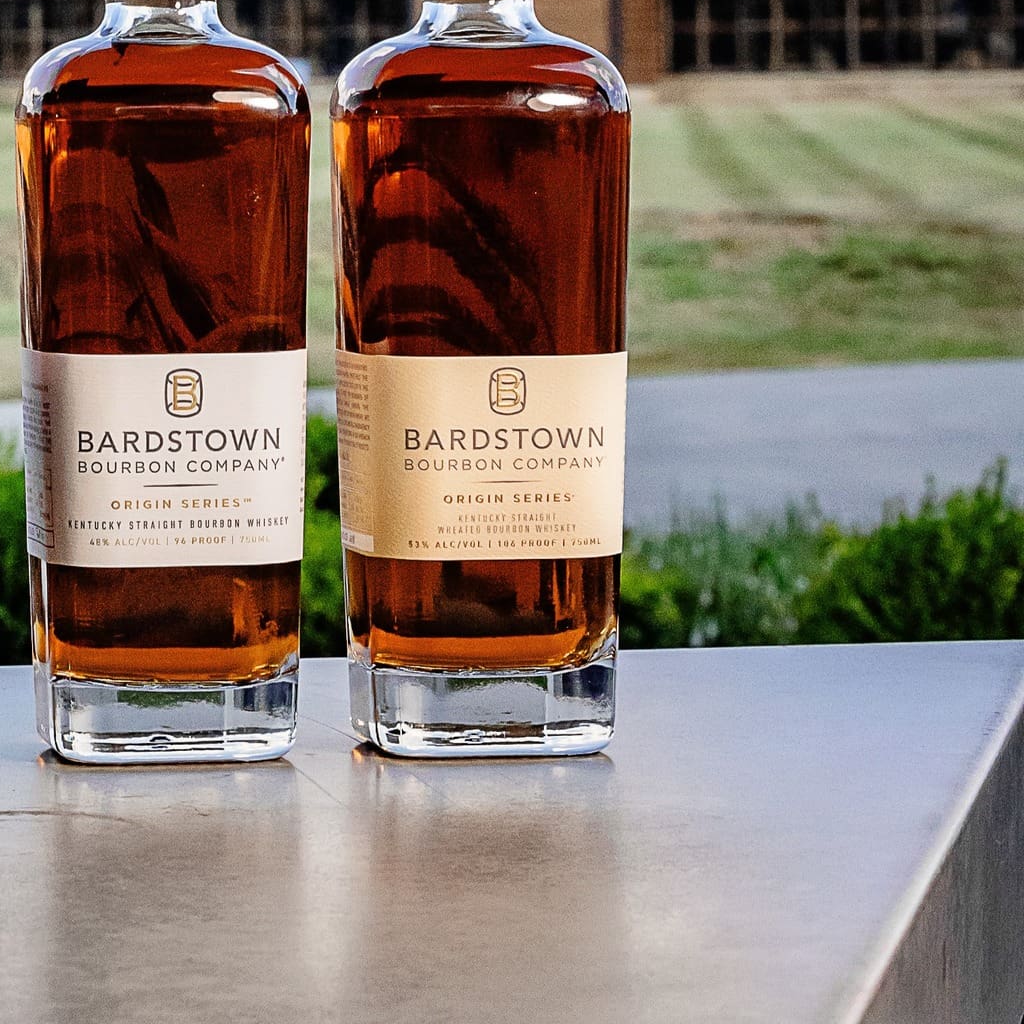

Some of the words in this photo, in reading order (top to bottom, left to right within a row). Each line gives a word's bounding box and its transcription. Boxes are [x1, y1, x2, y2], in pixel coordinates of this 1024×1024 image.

[173, 375, 197, 410] B
[497, 374, 520, 407] B
[77, 428, 280, 453] BARDSTOWN
[405, 426, 604, 450] BARDSTOWN
[79, 461, 175, 474] BOURBON
[405, 459, 502, 471] BOURBON
[513, 456, 603, 470] COMPANY
[111, 500, 171, 510] ORIGIN
[443, 494, 503, 504] ORIGIN
[68, 520, 121, 530] KENTUCKY
[129, 520, 183, 529] STRAIGHT
[190, 519, 240, 528] BOURBON
[247, 516, 289, 527] WHISKEY
[458, 513, 506, 523] KENTUCKY
[511, 512, 556, 521] STRAIGHT
[438, 526, 481, 534] WHEATED
[487, 525, 530, 534] BOURBON
[535, 524, 576, 533] WHISKEY
[90, 538, 109, 546] 48%
[115, 537, 160, 546] ALC/VOL
[174, 537, 186, 545] 96
[192, 536, 226, 544] PROOF
[435, 539, 482, 549] ALC/VOL
[498, 539, 515, 547] 106
[521, 538, 557, 547] PROOF
[571, 537, 601, 546] 750ML
